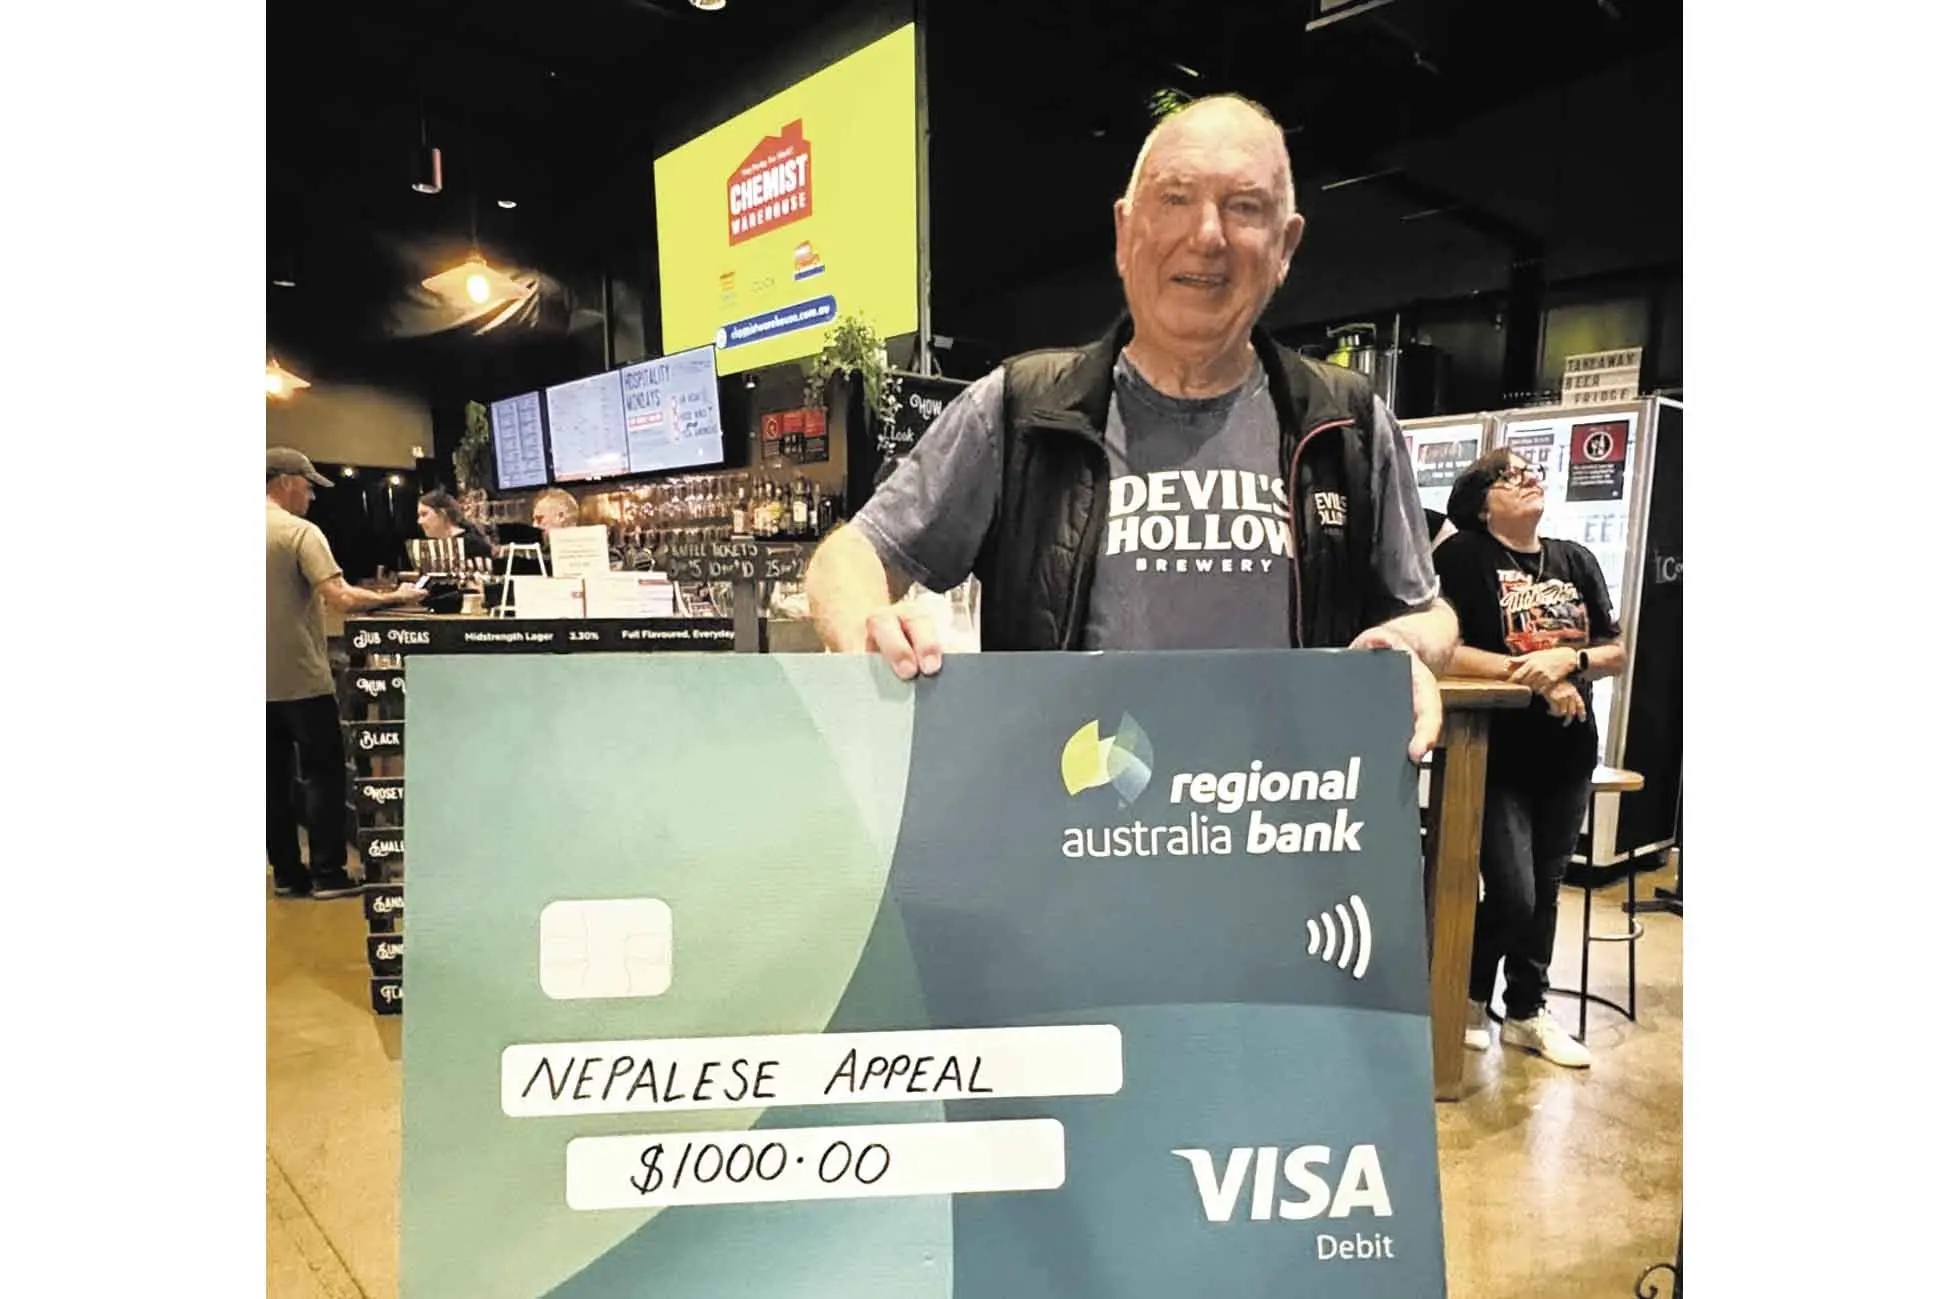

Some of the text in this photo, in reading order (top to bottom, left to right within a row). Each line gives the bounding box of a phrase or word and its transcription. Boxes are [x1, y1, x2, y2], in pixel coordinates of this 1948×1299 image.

[730, 153, 808, 216] CHEMIST
[731, 191, 806, 236] WAREHOUSE
[1109, 469, 1291, 518] DEVIL'S
[1105, 514, 1295, 560] HOLLOW
[1136, 557, 1273, 574] BREWERY
[387, 629, 430, 645] VEGAS
[464, 632, 524, 643] Midstrength
[525, 632, 554, 643] Lager
[621, 630, 640, 640] Full
[360, 730, 400, 750] BLACK
[1170, 756, 1361, 814] regional
[1062, 808, 1365, 858] australia bank
[521, 1048, 995, 1104] NEPALESE APPEAL
[1170, 1144, 1393, 1222] VISA
[1316, 1232, 1395, 1261] Debit
